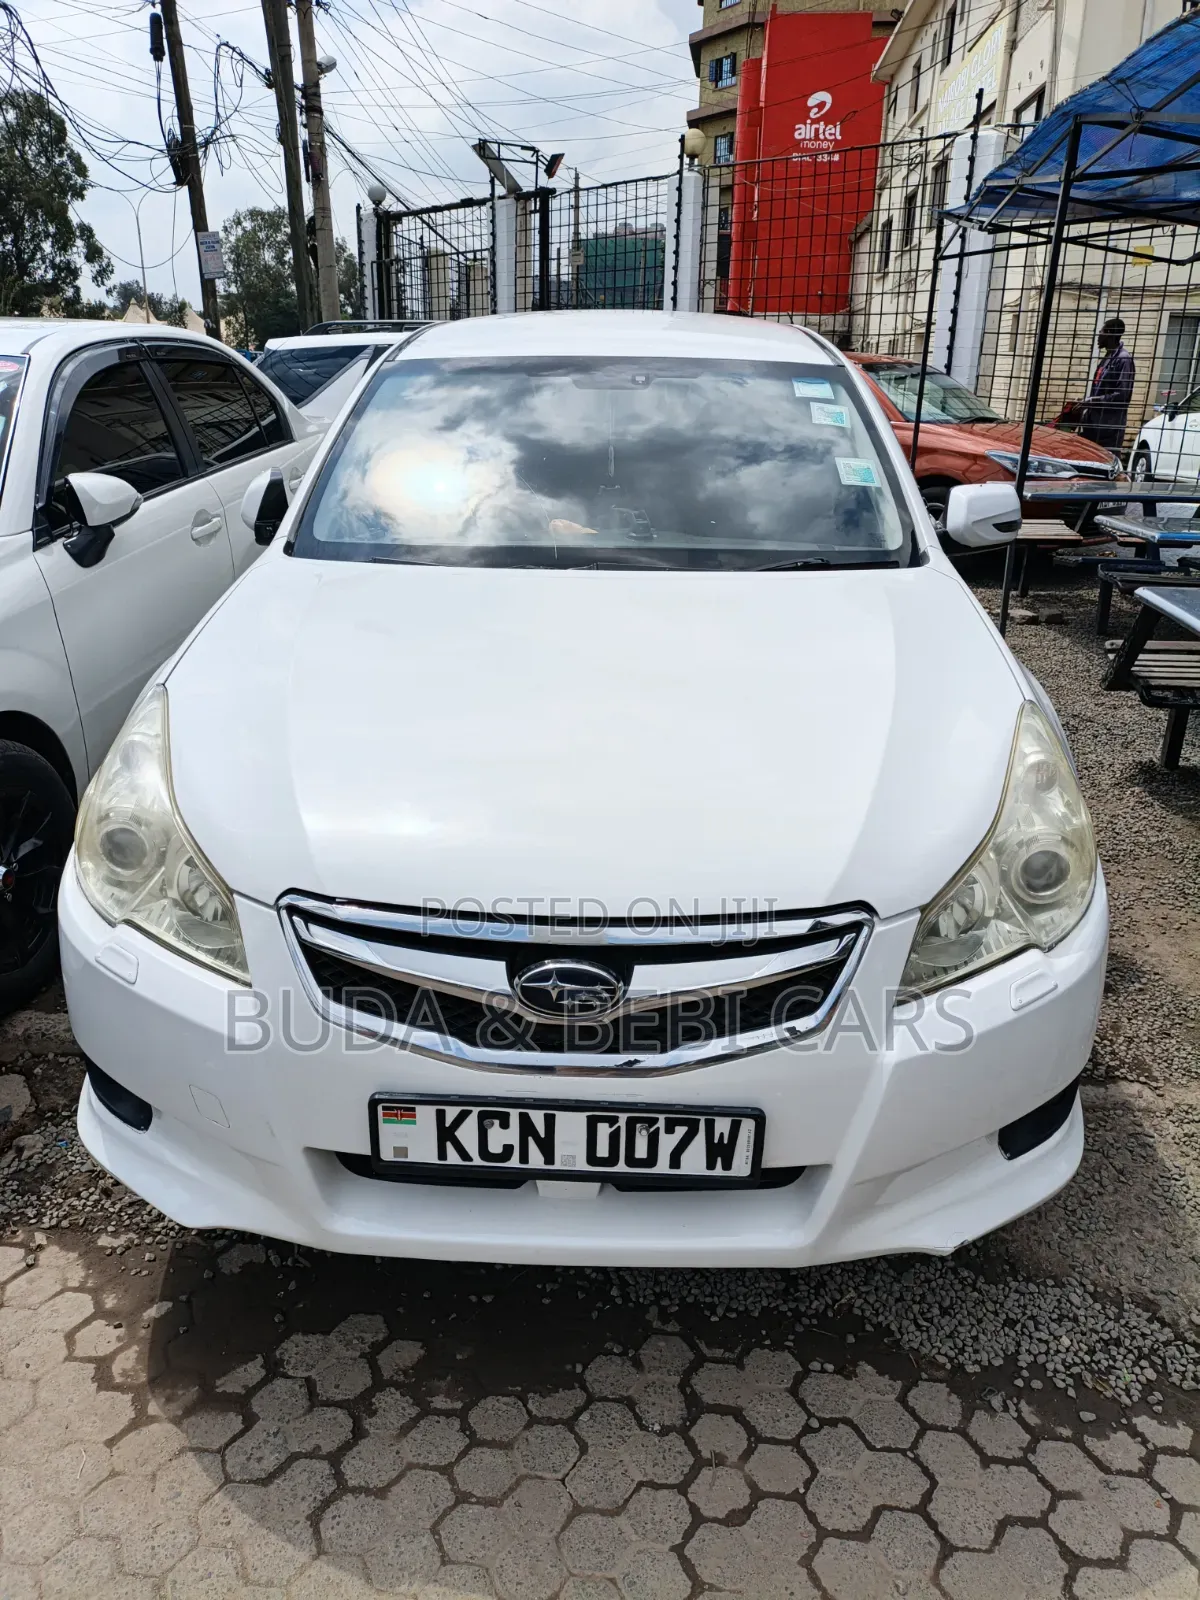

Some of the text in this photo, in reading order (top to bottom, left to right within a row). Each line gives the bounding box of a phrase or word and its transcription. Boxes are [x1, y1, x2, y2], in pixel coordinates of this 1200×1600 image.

[794, 119, 842, 140] airtel
[800, 140, 835, 151] money
[435, 1108, 557, 1165] KCN
[585, 1114, 742, 1171] 007W
